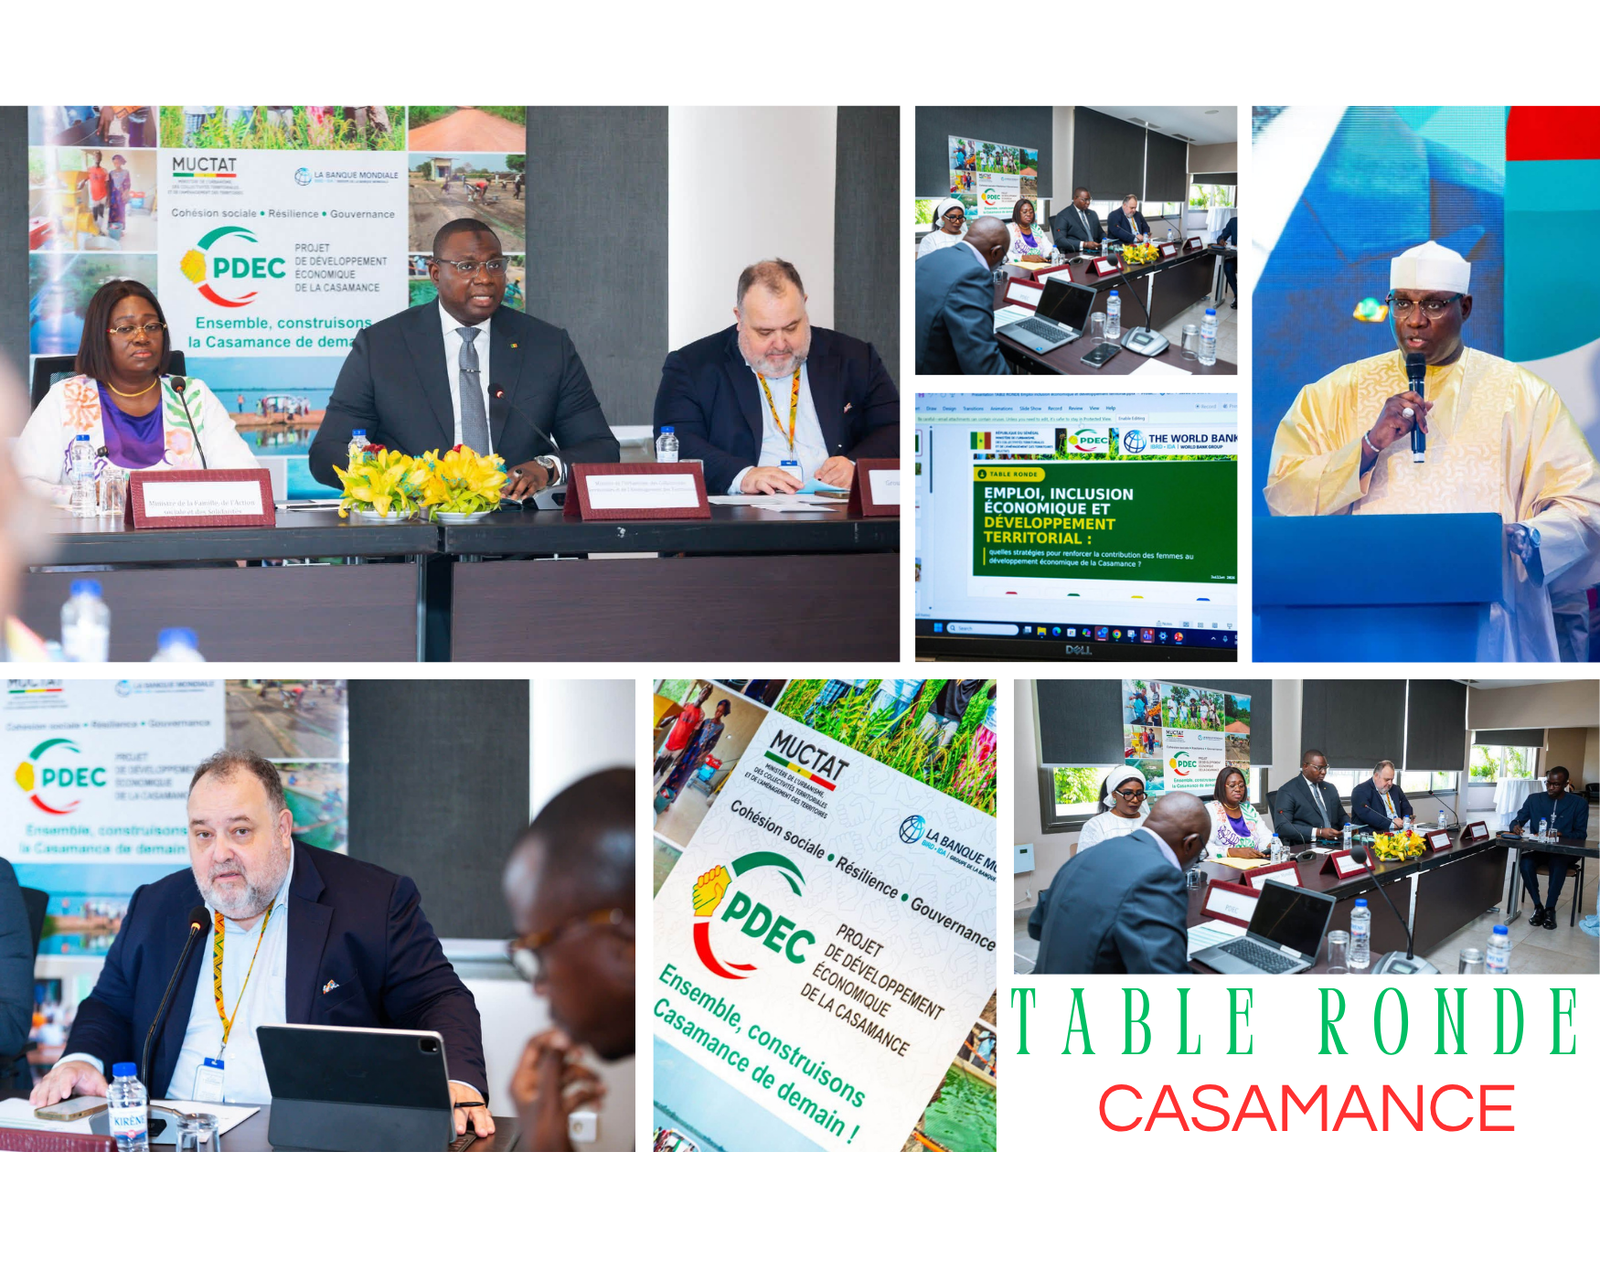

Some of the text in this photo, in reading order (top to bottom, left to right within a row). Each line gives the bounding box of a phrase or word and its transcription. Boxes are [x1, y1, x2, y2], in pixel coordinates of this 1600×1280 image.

[172, 157, 237, 171] MUCTAT
[314, 171, 324, 179] LA
[325, 171, 357, 179] BANQUE
[171, 208, 395, 219] Cohésion sociale Résilience Gouvernance
[295, 243, 330, 253] PROJET
[295, 255, 387, 266] DE DÉVELOPPEMENT
[213, 257, 287, 279] PDEC
[295, 268, 356, 280] ÉCONOMIQUE
[295, 283, 380, 293] DE LA CASAMANCE
[195, 316, 372, 331] Ensemble, construisons
[188, 336, 354, 349] la Casamance de dema
[1149, 433, 1238, 443] THE WORLD BANK
[984, 487, 1134, 502] EMPLOI, INCLUSION
[984, 500, 1111, 517] ÉCONOMIQUE ET
[983, 514, 1116, 530] DÉVELOPPEMENT
[983, 531, 1082, 545] TERRITORIAL
[989, 549, 1011, 557] quelles
[1013, 549, 1045, 557] stratégies
[1062, 549, 1092, 557] renforcer
[1101, 550, 1140, 558] contribution
[1142, 551, 1154, 559] des
[1156, 552, 1184, 560] femmes
[989, 557, 1038, 566] développement
[1039, 558, 1079, 567] économique
[1065, 645, 1092, 655] DELL
[769, 729, 850, 781] MUCTAT
[128, 764, 197, 775] DÉVELOPPEMEN
[1177, 760, 1197, 768] PDEC
[42, 767, 107, 787] PDEC
[765, 763, 825, 798] MINISTÈRE DE L'URBANISME,
[753, 766, 828, 809] DES COLLECTIVITÉS TERRITORIALES
[141, 791, 188, 800] CASAMANC
[790, 796, 800, 805] DES
[800, 801, 828, 819] TERRITOIRES
[25, 824, 188, 837] Ensemble, construisons
[19, 843, 186, 855] la Casamance de demain
[925, 828, 940, 843] LA
[940, 835, 985, 865] BANQUE
[730, 799, 996, 952] Cohésion sociale Résilience Gouvernance
[720, 890, 816, 965] PDEC
[835, 923, 884, 959] PROJET
[824, 943, 945, 1021] DE DÉVELOPPEMENT
[812, 961, 891, 1018] ÉCONOMIQUE
[800, 982, 910, 1057] DE LA CASAMANCE
[658, 963, 866, 1108] Ensemble, construisons
[653, 998, 750, 1072] Casamance
[751, 1064, 775, 1089] de
[777, 1081, 845, 1137] demain
[114, 1115, 146, 1126] KIRÈNE
